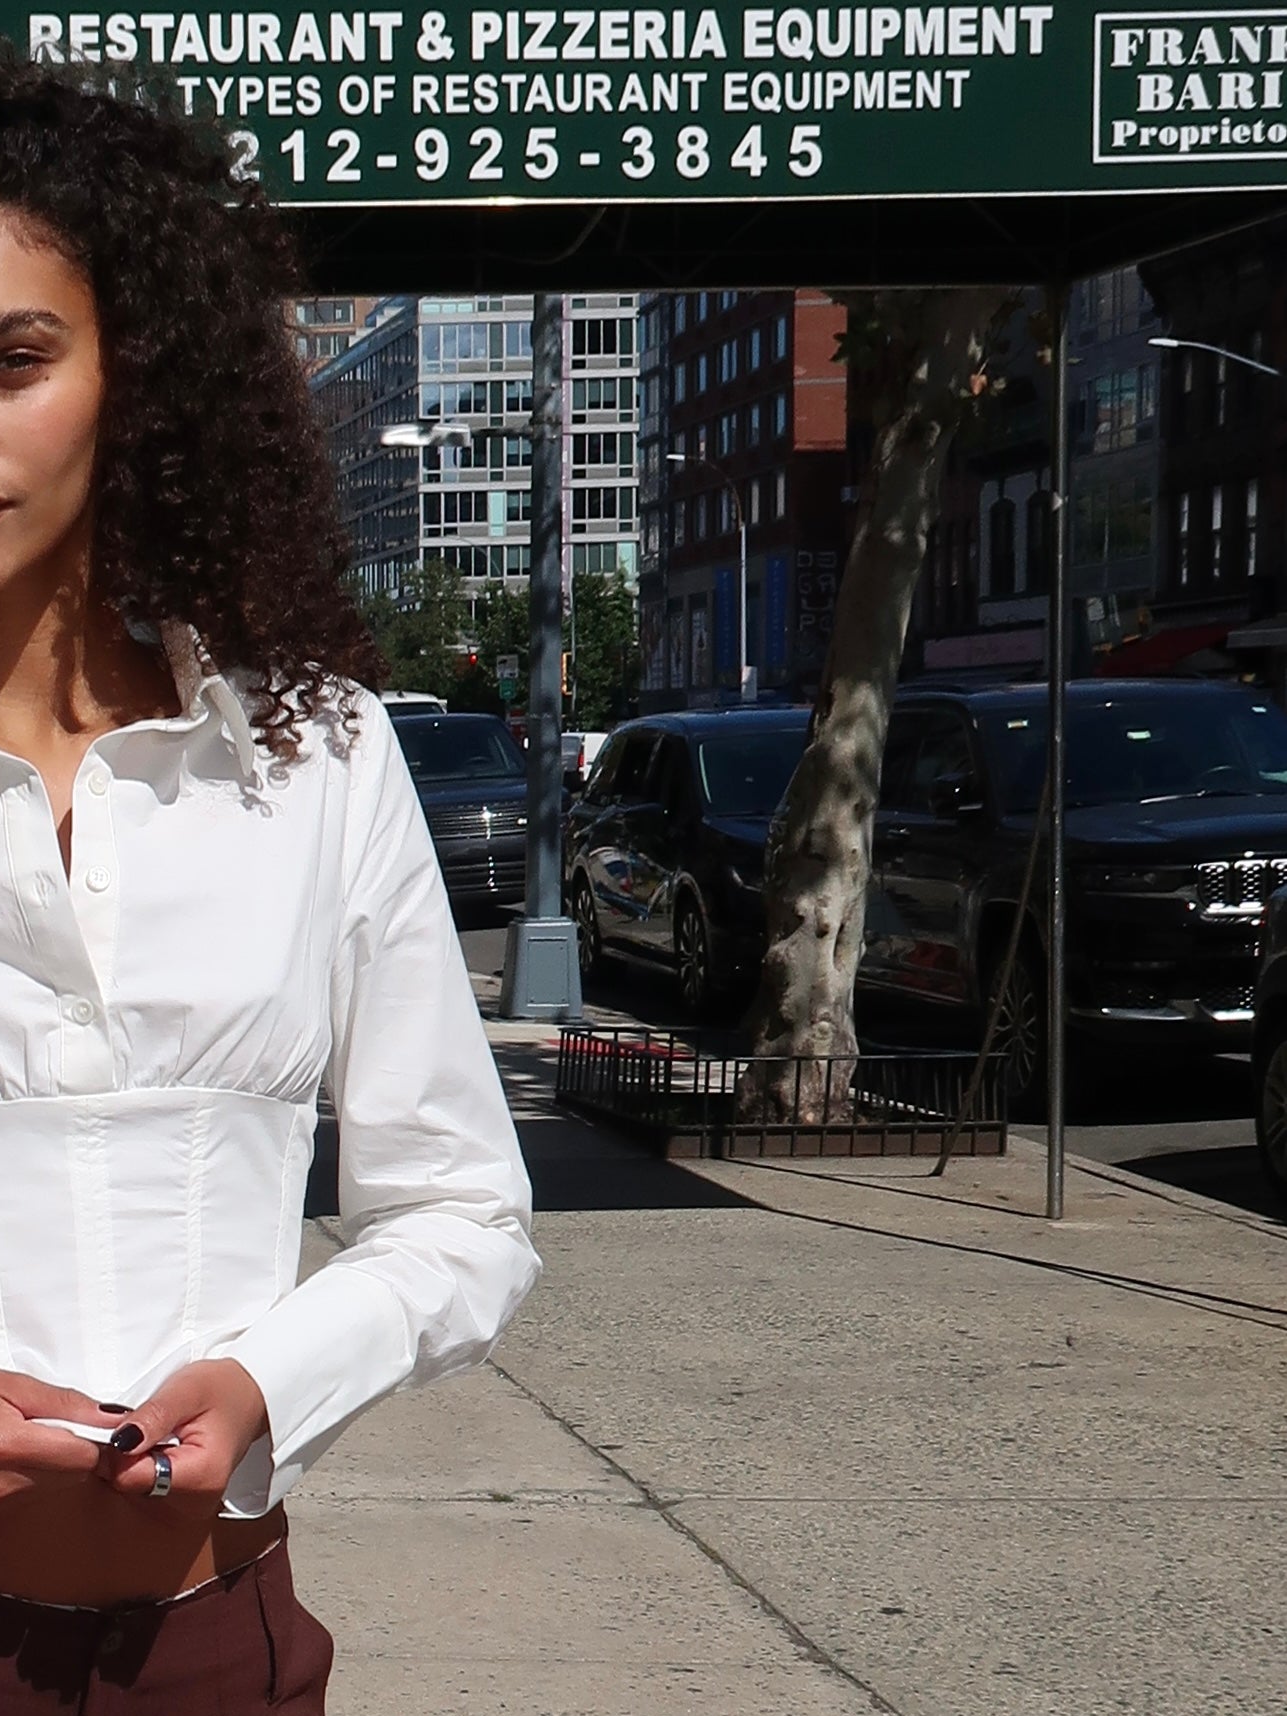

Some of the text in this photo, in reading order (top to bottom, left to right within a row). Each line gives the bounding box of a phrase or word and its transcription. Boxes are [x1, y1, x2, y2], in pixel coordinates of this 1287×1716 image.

[28, 5, 1053, 64] RESTAURANT & PIZZERIA EQUIPMENT
[177, 75, 321, 117] TYPES
[339, 74, 396, 115] OF
[412, 72, 707, 115] RESTAURANT
[723, 70, 971, 113] EQUIPMENT
[1137, 70, 1284, 112] BARI
